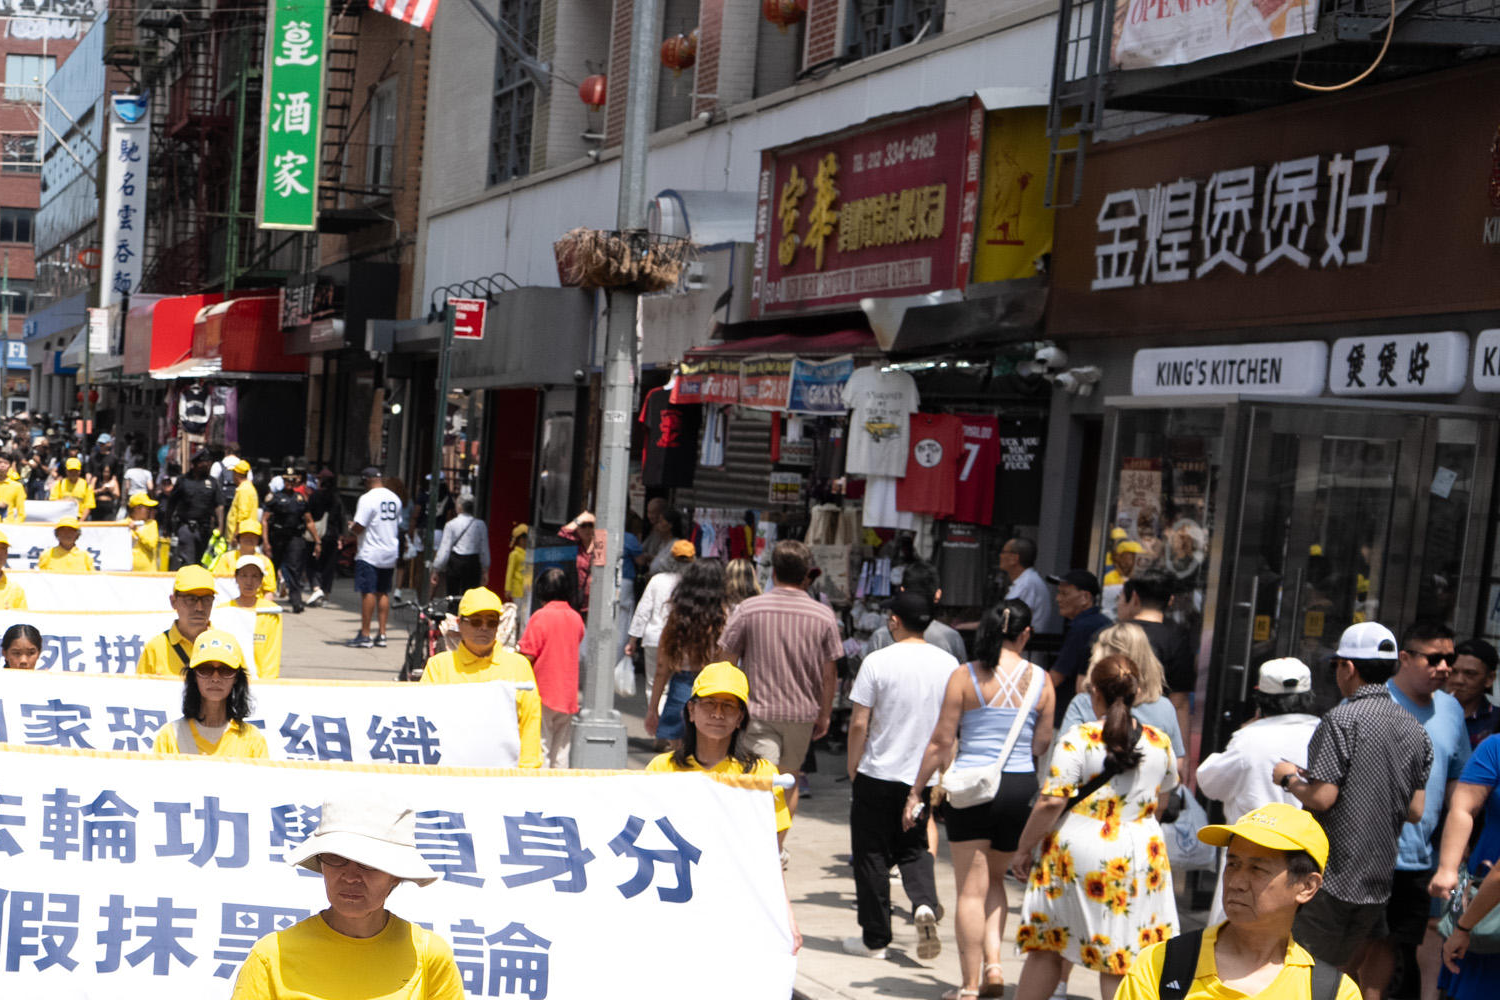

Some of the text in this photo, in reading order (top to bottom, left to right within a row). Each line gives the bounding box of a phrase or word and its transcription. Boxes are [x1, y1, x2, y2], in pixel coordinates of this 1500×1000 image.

[1156, 357, 1283, 387] KING'S KITCHEN
[960, 443, 980, 481] 7
[380, 501, 397, 521] 99
